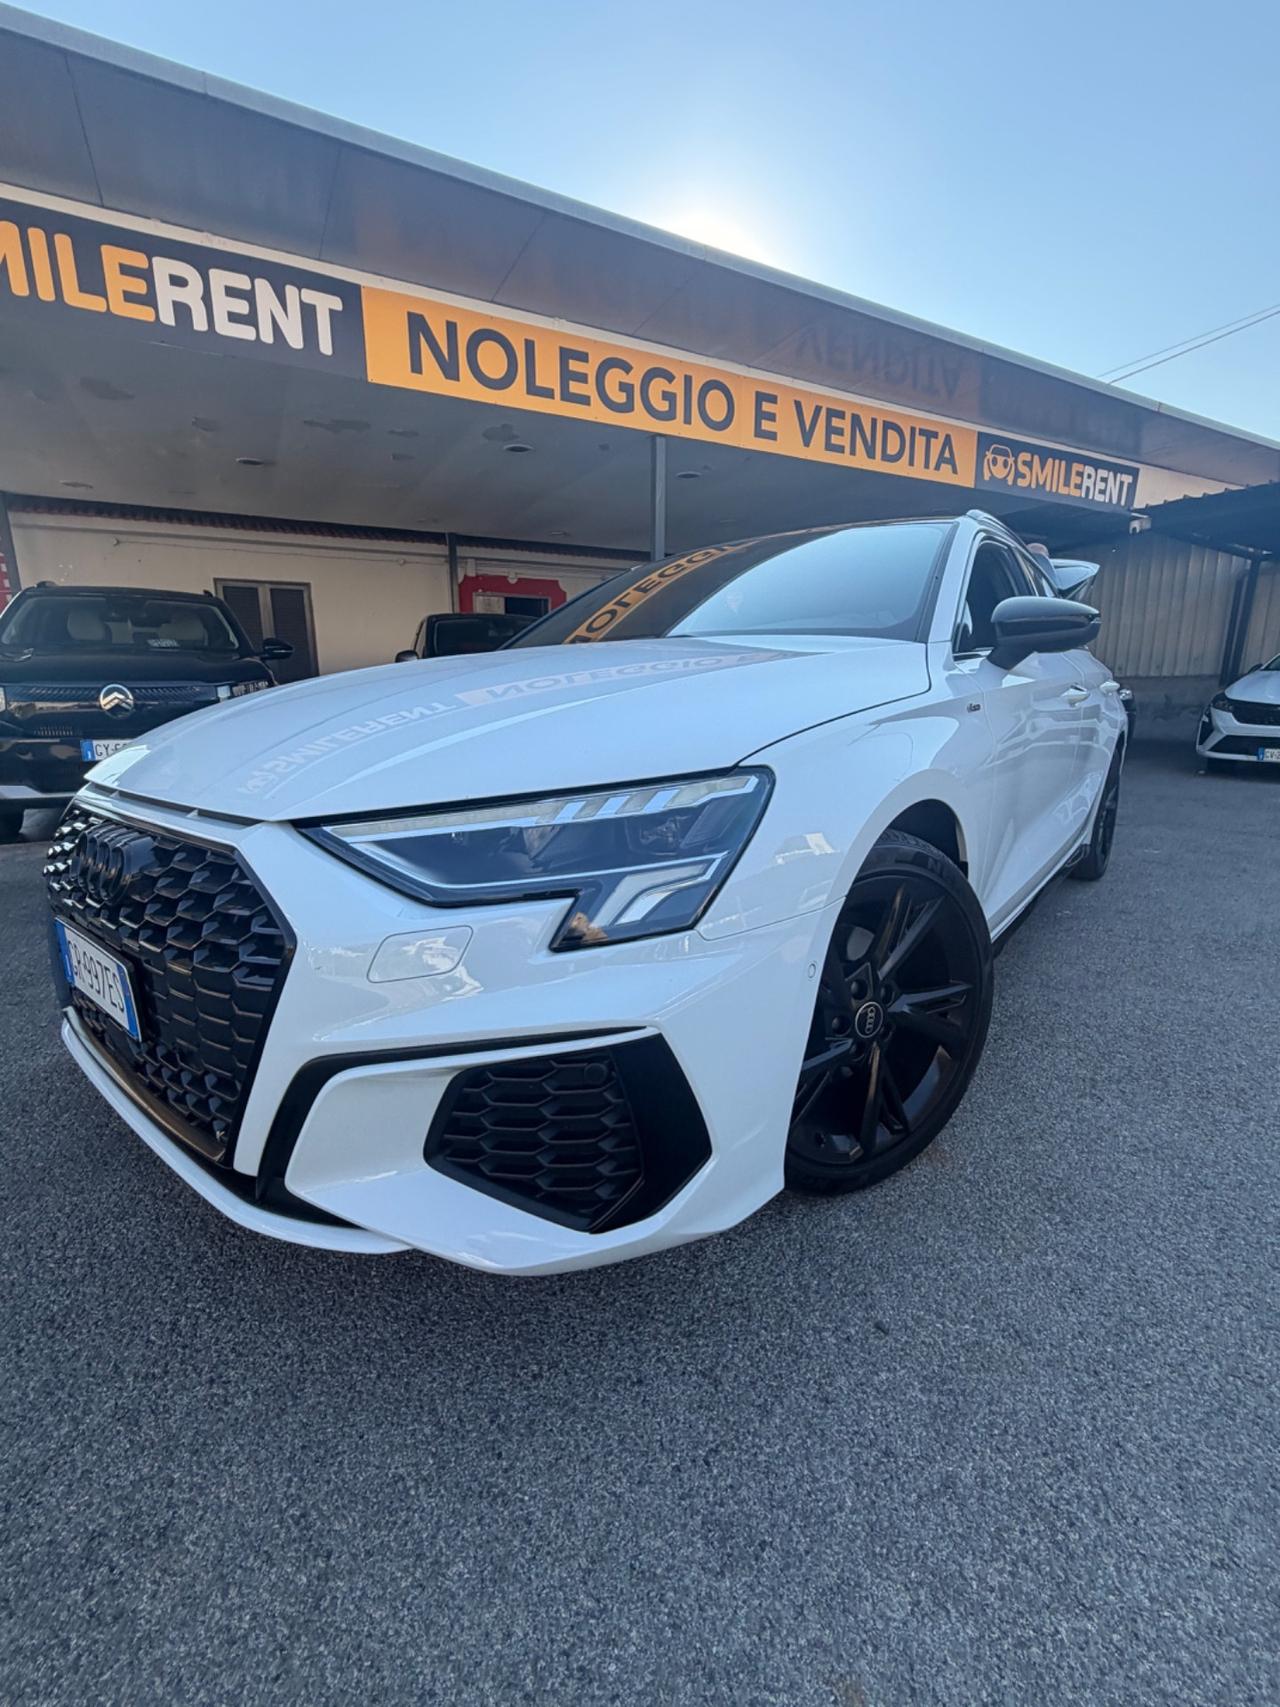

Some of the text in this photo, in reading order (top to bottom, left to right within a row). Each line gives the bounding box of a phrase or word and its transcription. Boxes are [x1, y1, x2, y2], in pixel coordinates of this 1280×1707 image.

[406, 311, 960, 475] NOLEGGIO E VENDITA
[1017, 452, 1133, 507] SMILERENT
